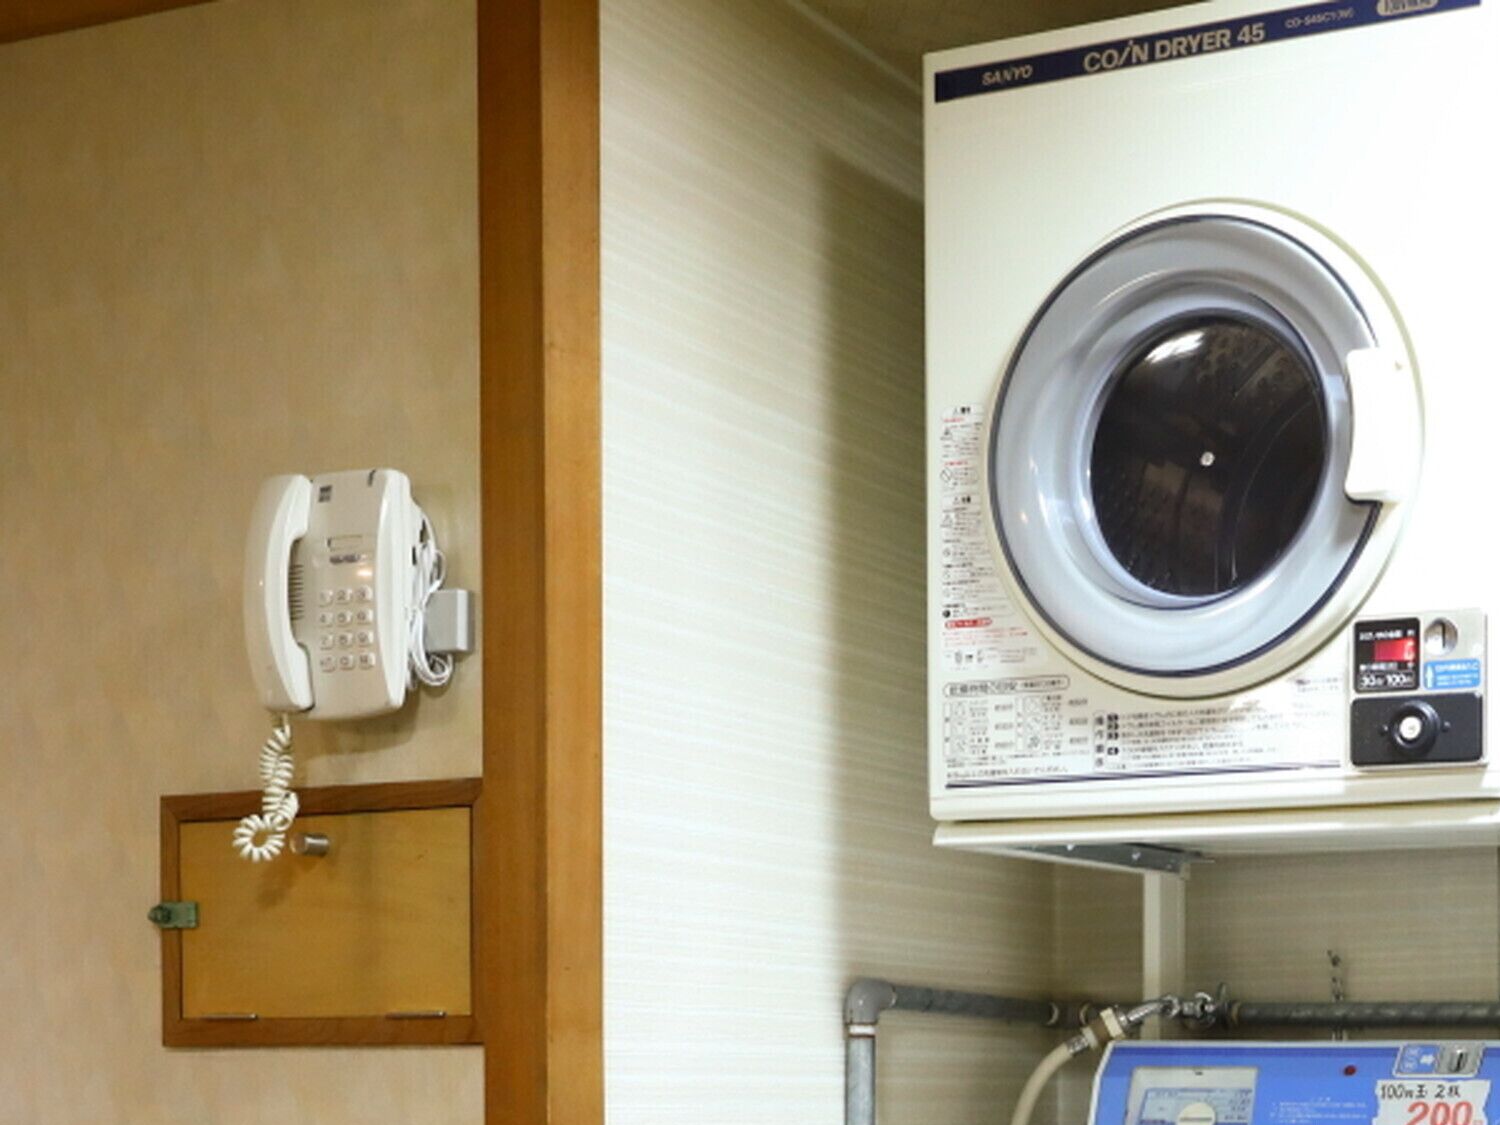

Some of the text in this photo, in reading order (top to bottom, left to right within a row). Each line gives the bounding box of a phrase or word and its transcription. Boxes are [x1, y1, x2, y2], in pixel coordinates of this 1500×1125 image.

[1155, 29, 1232, 59] DRYER
[1237, 22, 1266, 44] 45
[982, 64, 1033, 86] SANYO
